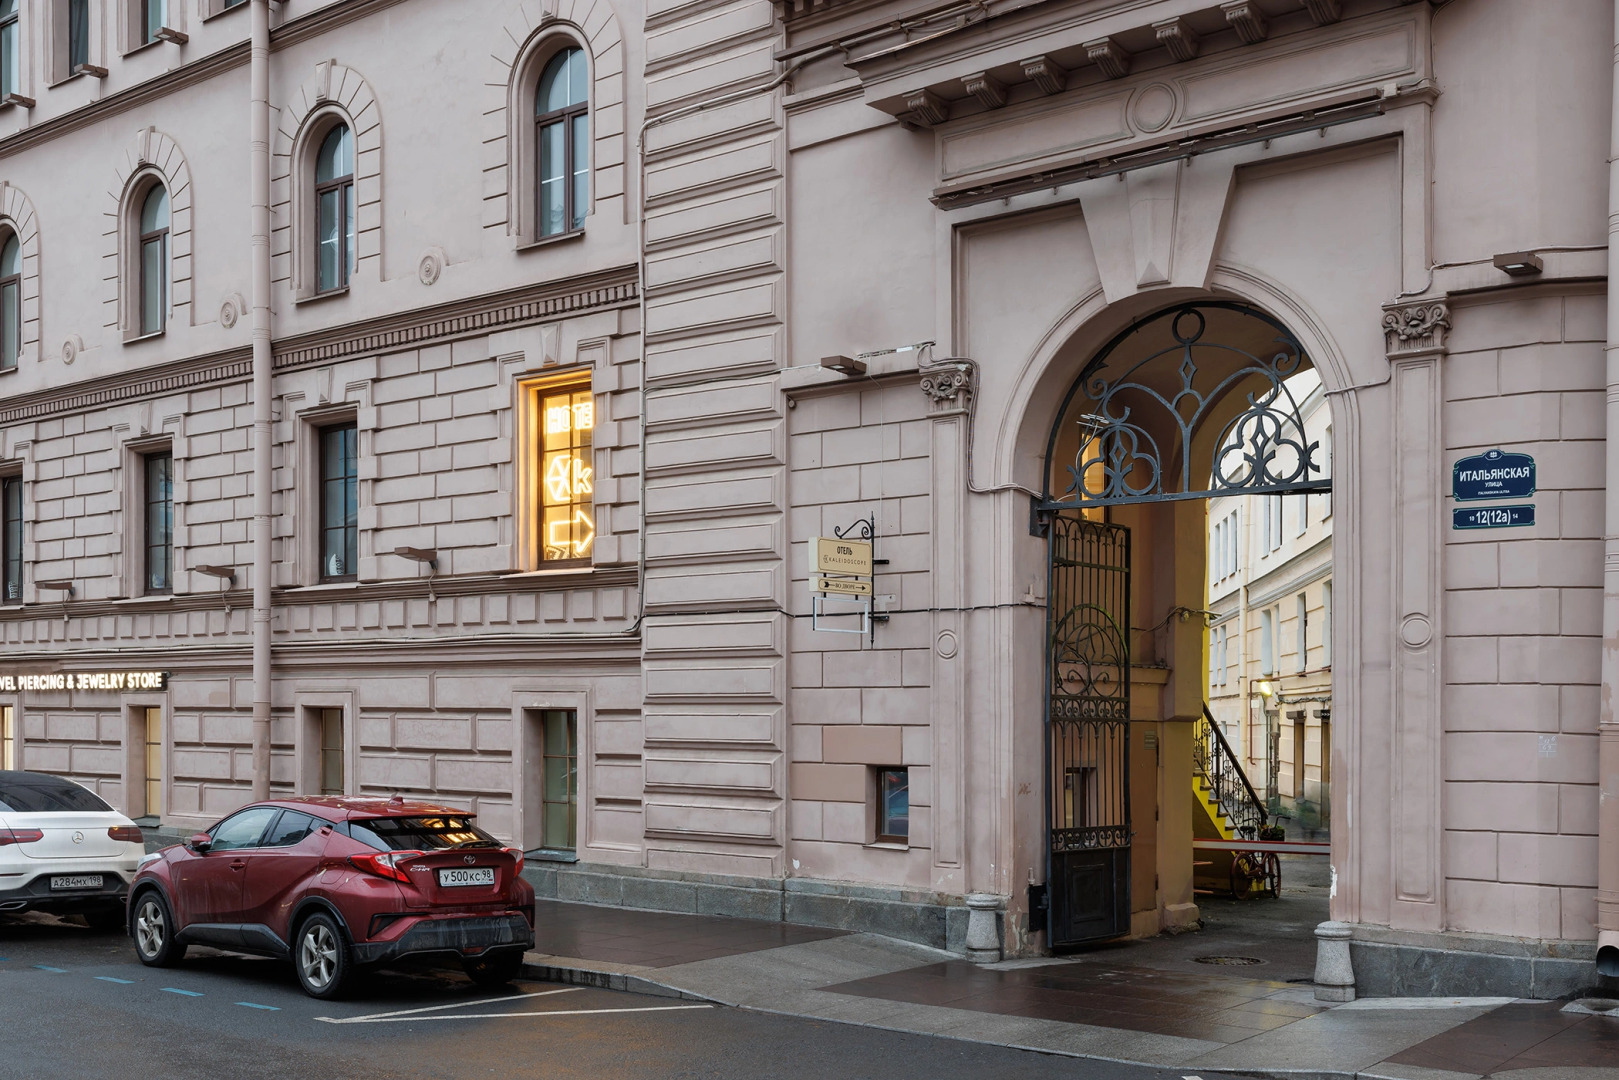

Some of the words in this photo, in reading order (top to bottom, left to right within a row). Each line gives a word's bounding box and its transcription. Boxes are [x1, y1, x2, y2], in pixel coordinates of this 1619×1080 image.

[1459, 467, 1530, 482] ИТАЛЬЯНСКАЯ
[836, 546, 853, 555] ОТЕЛЬ
[828, 557, 867, 566] KALEIDOSCOPE
[18, 674, 64, 690] PIERCING
[66, 674, 75, 689] &
[76, 672, 126, 690] JEWELRY
[127, 671, 162, 688] STORE
